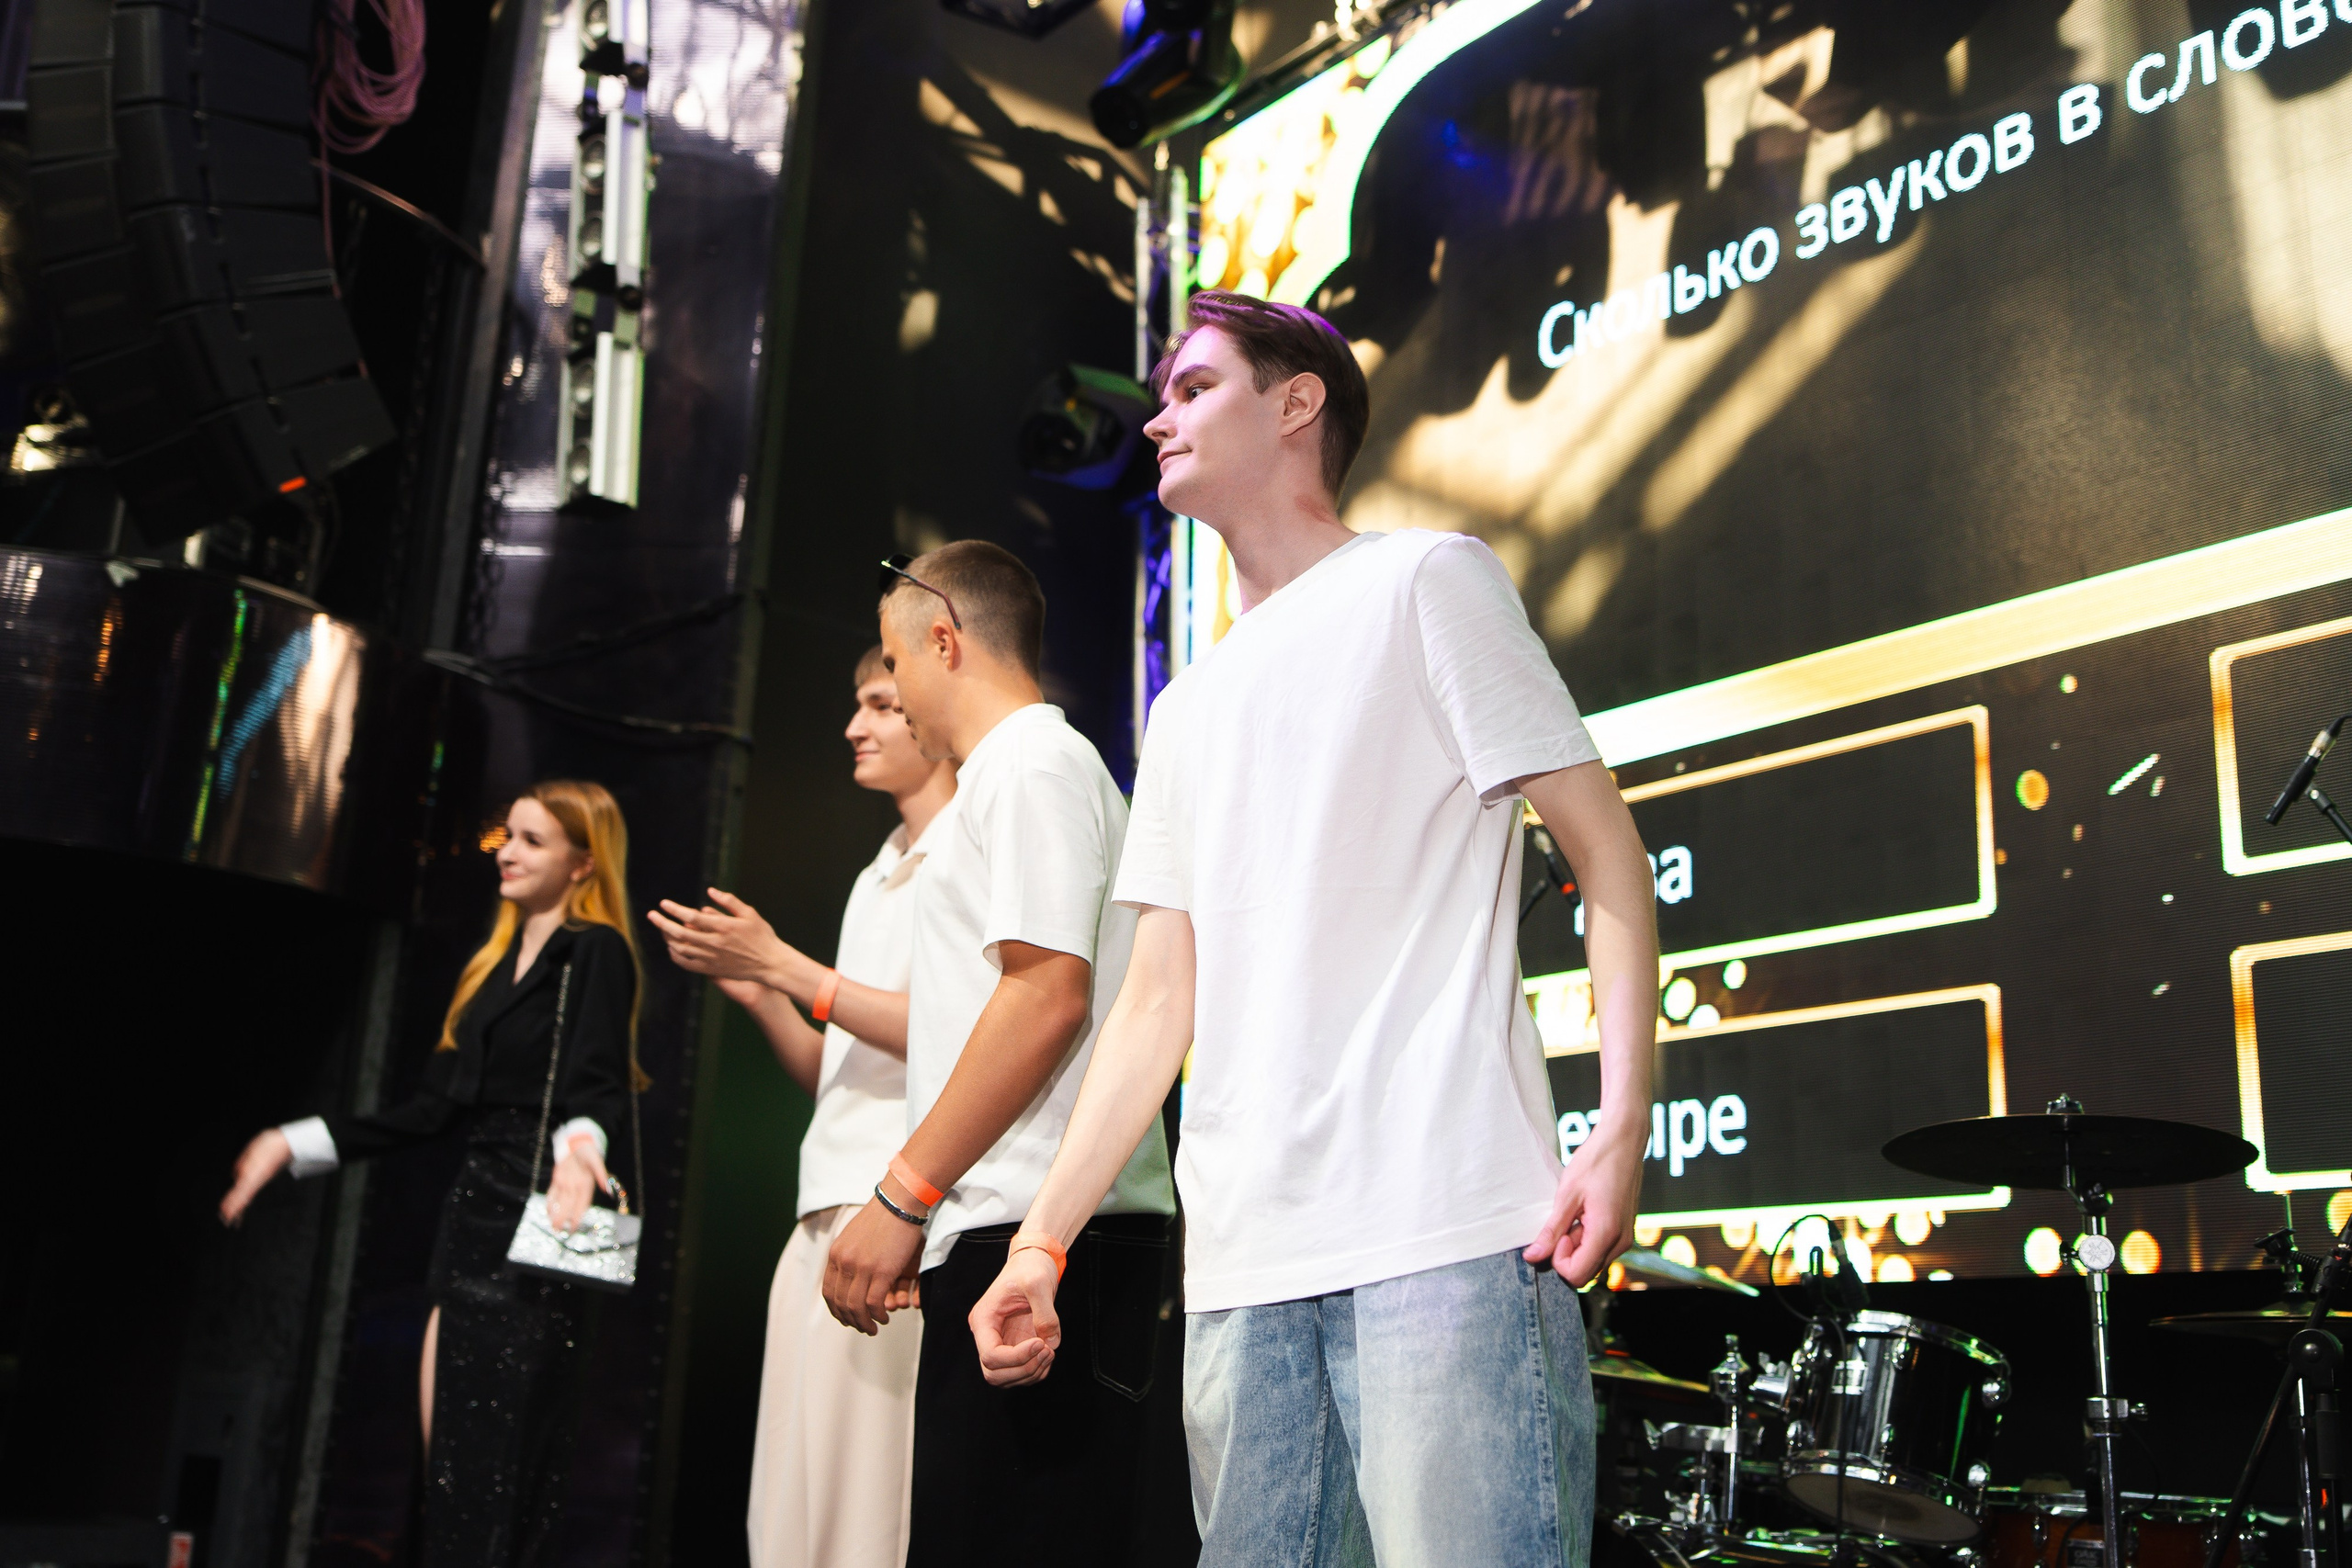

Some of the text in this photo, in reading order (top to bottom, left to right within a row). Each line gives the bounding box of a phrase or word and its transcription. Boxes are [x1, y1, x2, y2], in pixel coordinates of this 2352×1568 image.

[1537, 226, 1780, 369] Сколько
[1795, 112, 2036, 259] звуков
[2058, 83, 2102, 144] в
